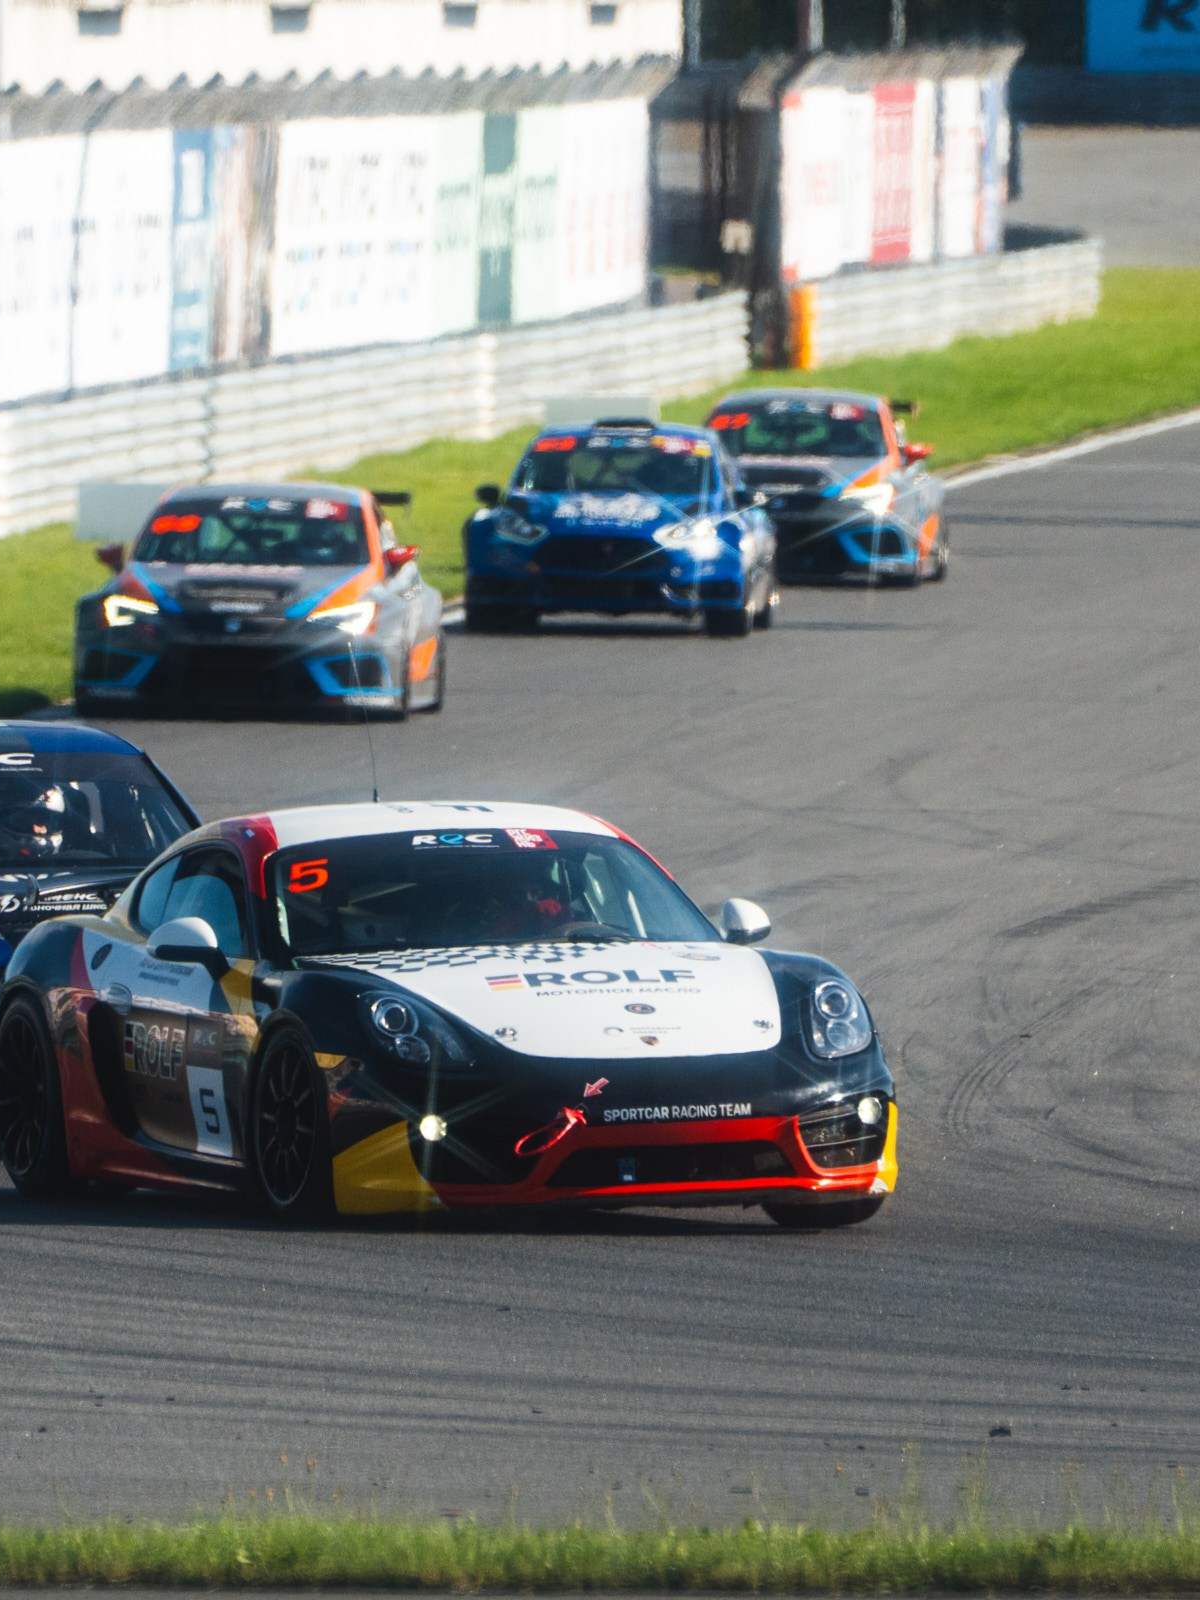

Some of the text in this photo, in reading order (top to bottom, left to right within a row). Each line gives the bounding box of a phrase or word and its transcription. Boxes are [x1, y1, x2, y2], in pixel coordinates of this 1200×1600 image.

[288, 858, 329, 893] 5
[522, 969, 696, 988] ROLF
[536, 987, 702, 997] МОТОРНОЕ МАСЛО
[132, 1020, 187, 1081] ROLF
[199, 1087, 220, 1134] 5
[603, 1102, 752, 1122] SPORTCAR RACING TEAM
